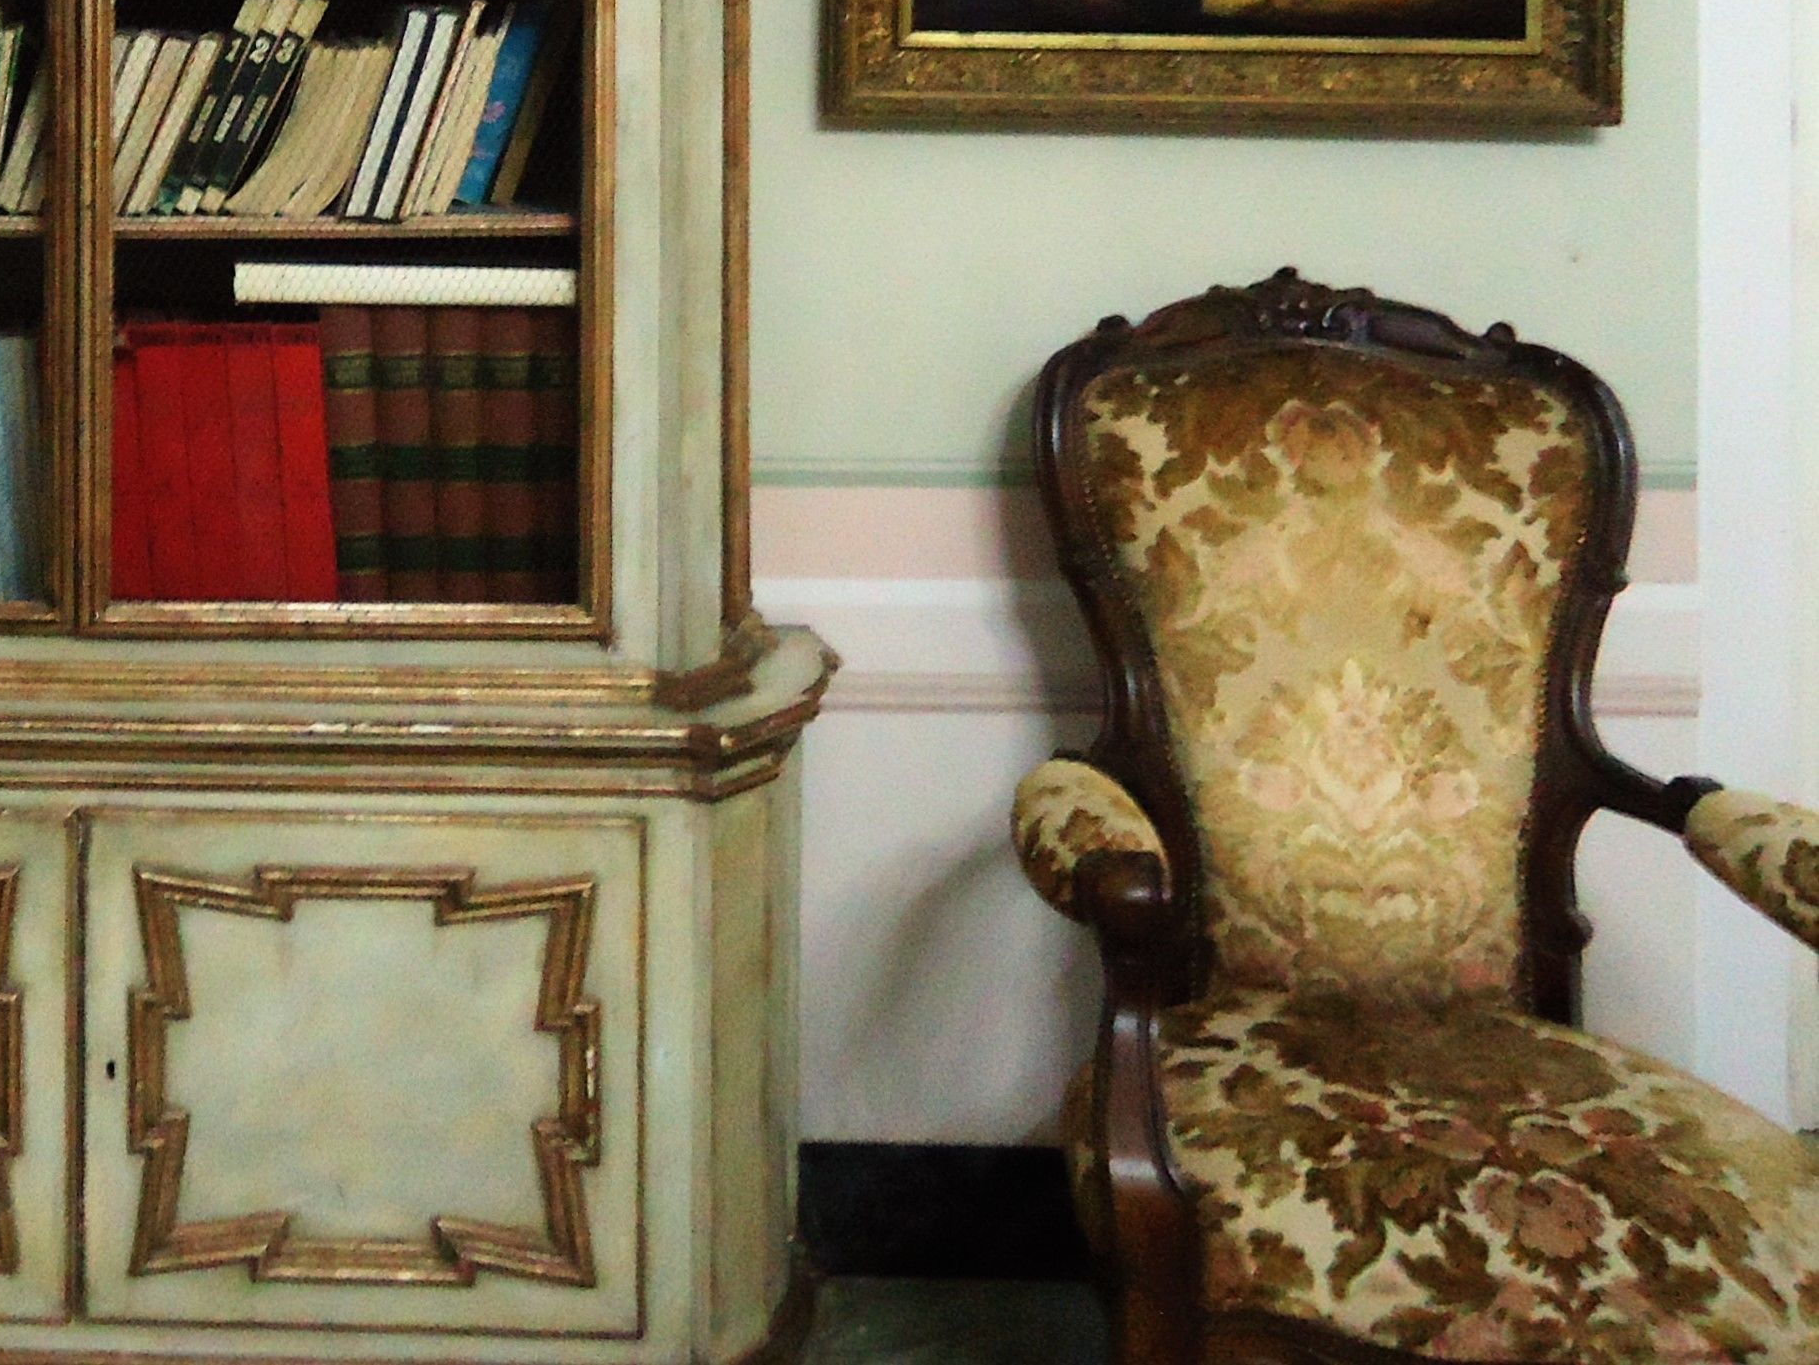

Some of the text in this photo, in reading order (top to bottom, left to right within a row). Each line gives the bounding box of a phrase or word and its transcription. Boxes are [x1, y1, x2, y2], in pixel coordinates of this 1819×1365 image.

[225, 37, 242, 63] 1
[249, 36, 270, 64] 2
[276, 37, 297, 64] 3
